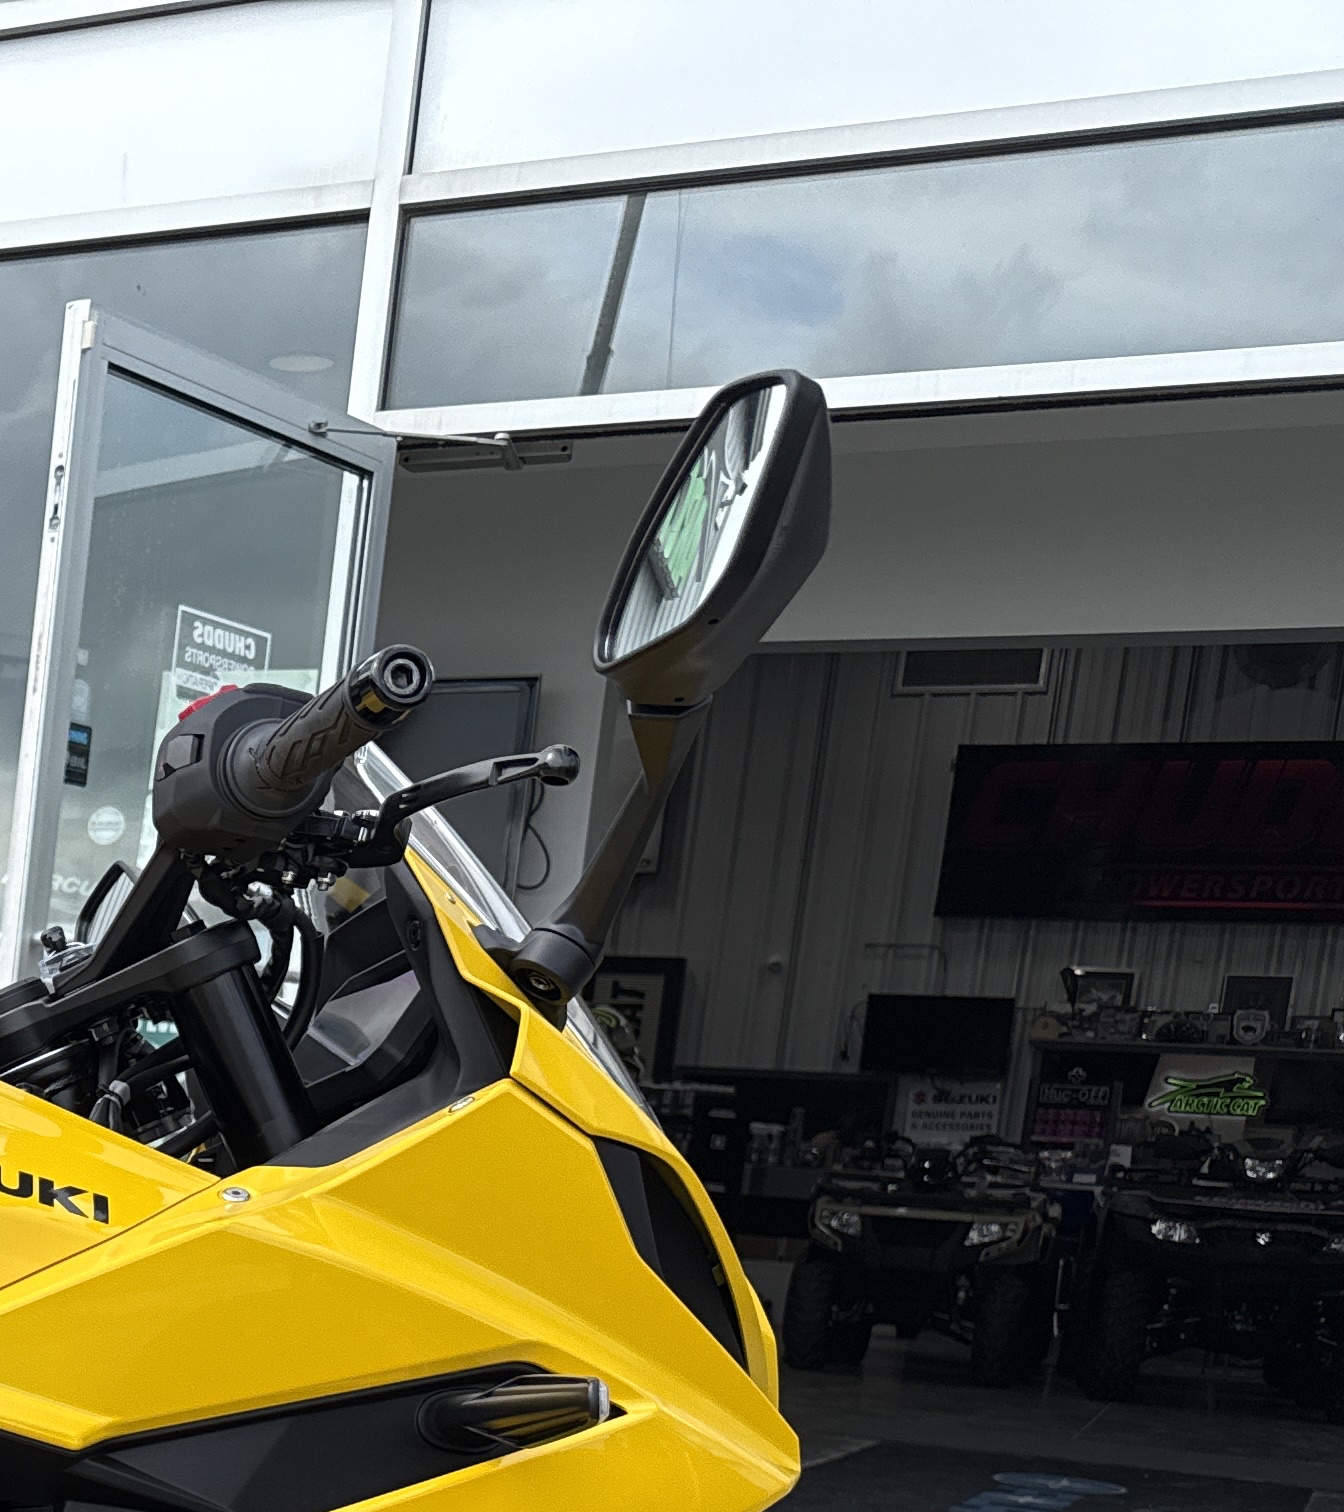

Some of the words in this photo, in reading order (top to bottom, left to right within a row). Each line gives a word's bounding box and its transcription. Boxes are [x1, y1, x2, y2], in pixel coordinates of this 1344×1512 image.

[1117, 871, 1344, 901] OWERSPORT
[911, 1109, 956, 1119] GENUINE
[960, 1110, 994, 1120] PARTS
[1170, 1095, 1230, 1114] ARCTIC
[1230, 1098, 1261, 1116] CAT
